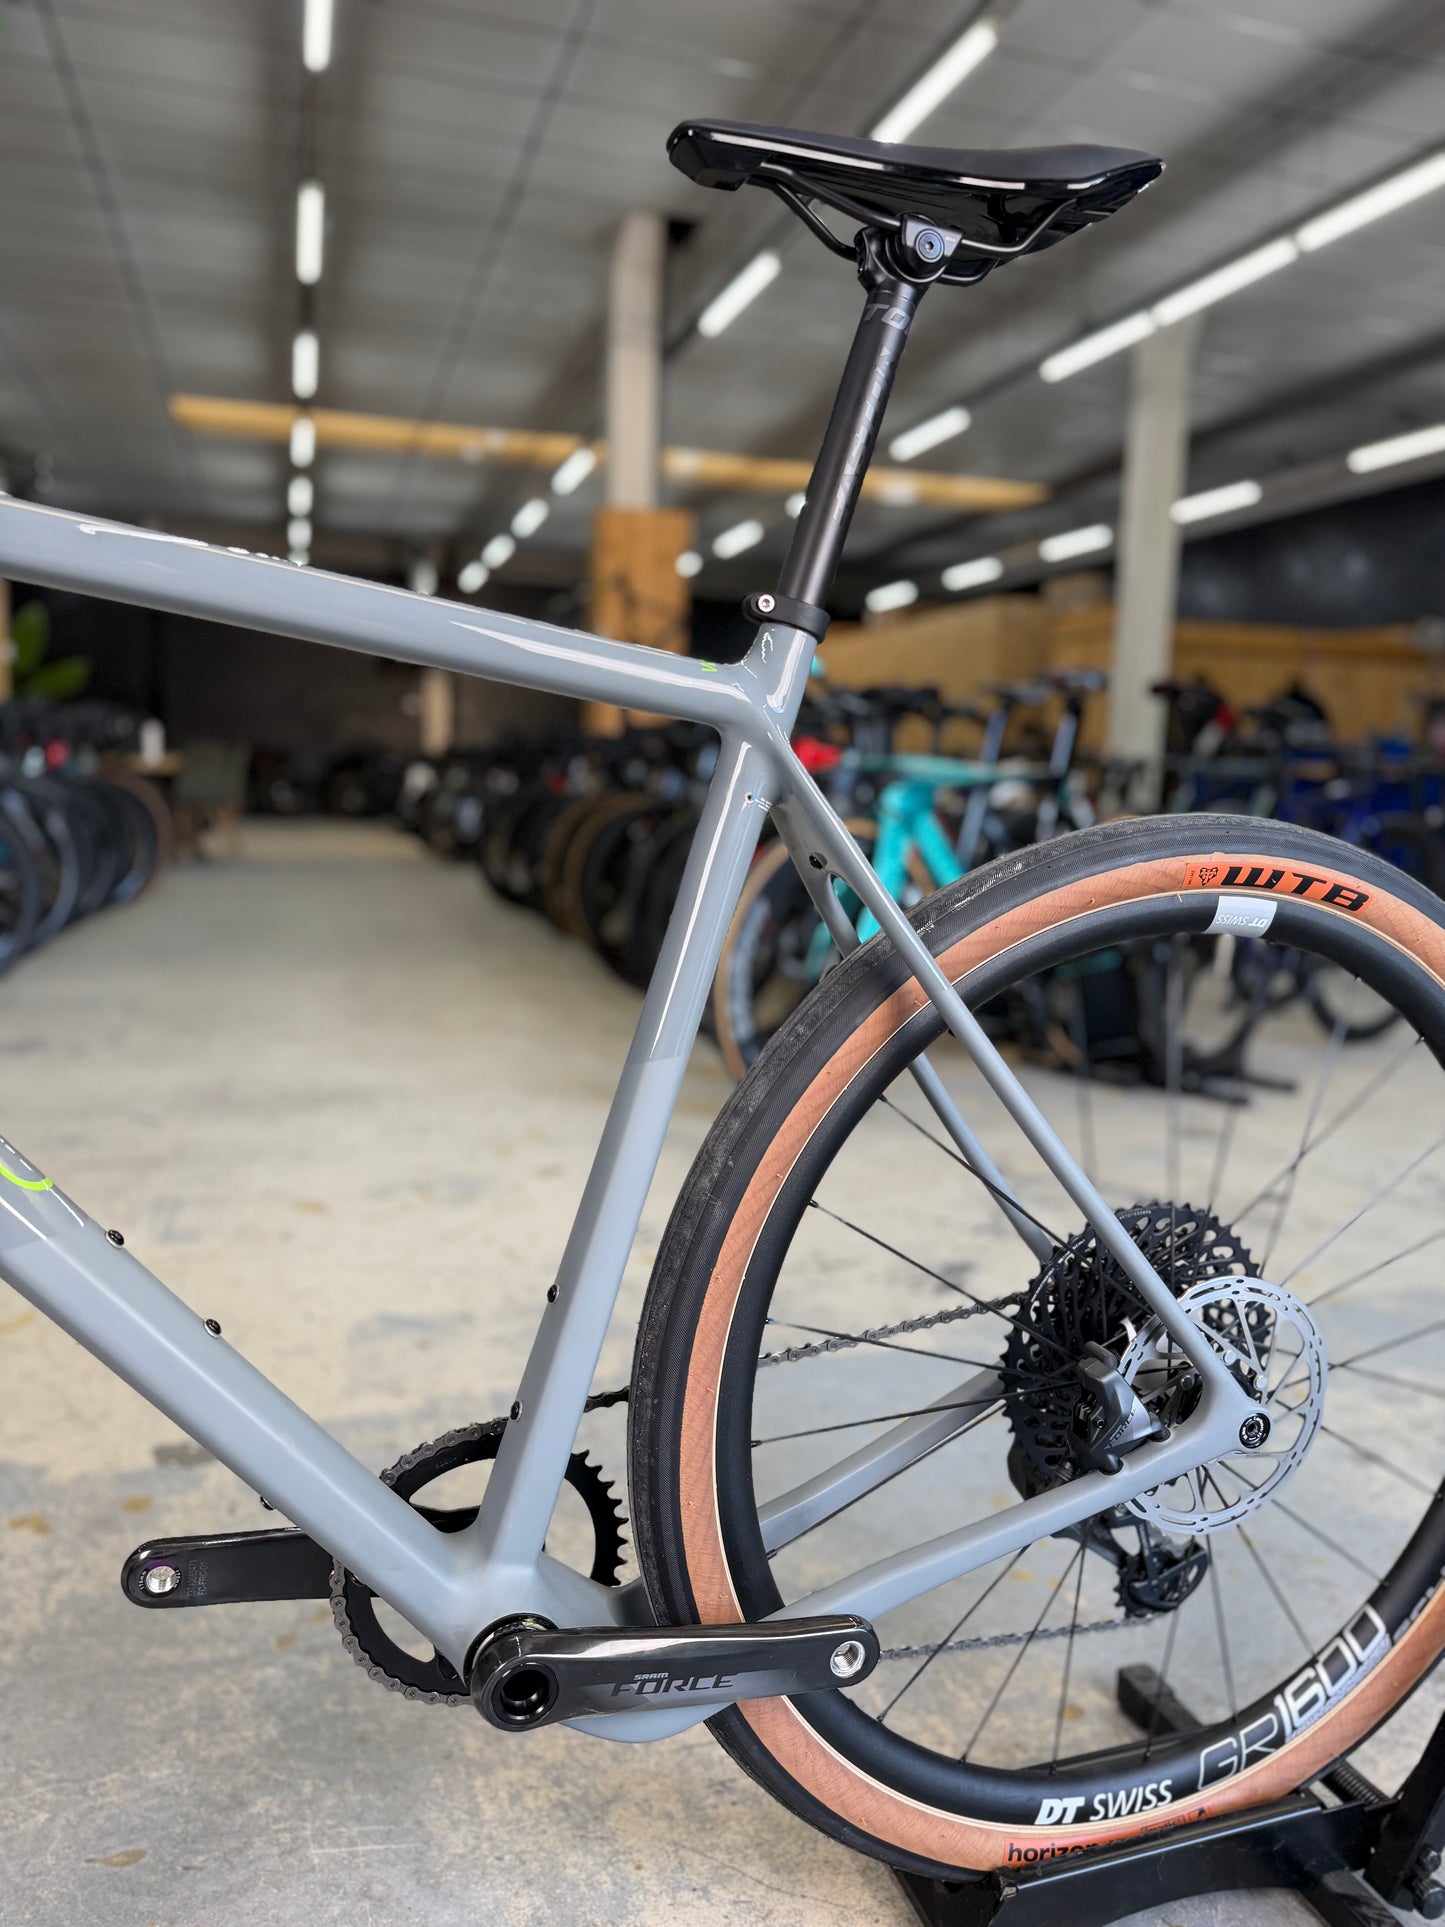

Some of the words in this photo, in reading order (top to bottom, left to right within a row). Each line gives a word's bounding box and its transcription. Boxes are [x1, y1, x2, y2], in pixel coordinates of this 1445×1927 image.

[1220, 866, 1369, 912] WTB
[1216, 914, 1249, 926] SWISS
[1248, 917, 1269, 928] DT
[611, 1674, 735, 1697] FORCE
[634, 1672, 669, 1681] SRAM
[1034, 1796, 1086, 1826] DT
[1089, 1779, 1173, 1822] SWISS
[1008, 1843, 1098, 1862] horiz
